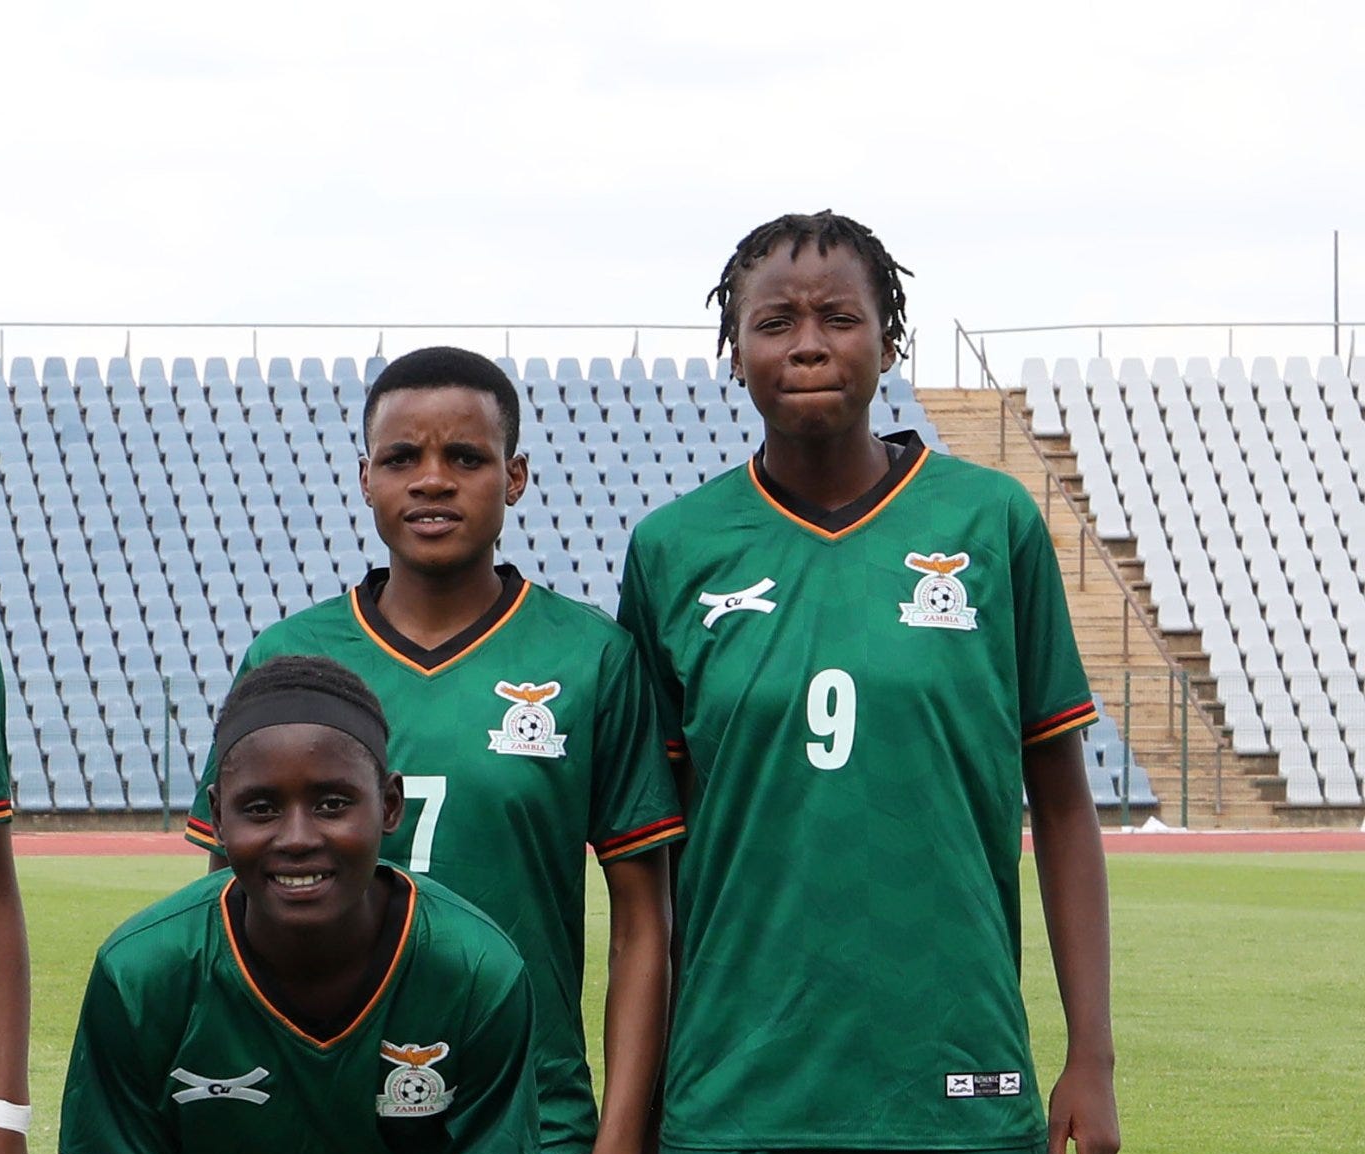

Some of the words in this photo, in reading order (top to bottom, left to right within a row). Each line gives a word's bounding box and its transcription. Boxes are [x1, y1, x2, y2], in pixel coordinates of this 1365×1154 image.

[725, 597, 743, 608] Cu
[923, 614, 959, 623] ZAMBIA
[806, 668, 856, 770] 9
[511, 743, 545, 751] ZAMBIA
[402, 776, 446, 872] 7
[209, 1083, 232, 1095] Cu
[394, 1105, 435, 1113] ZAMBIA
